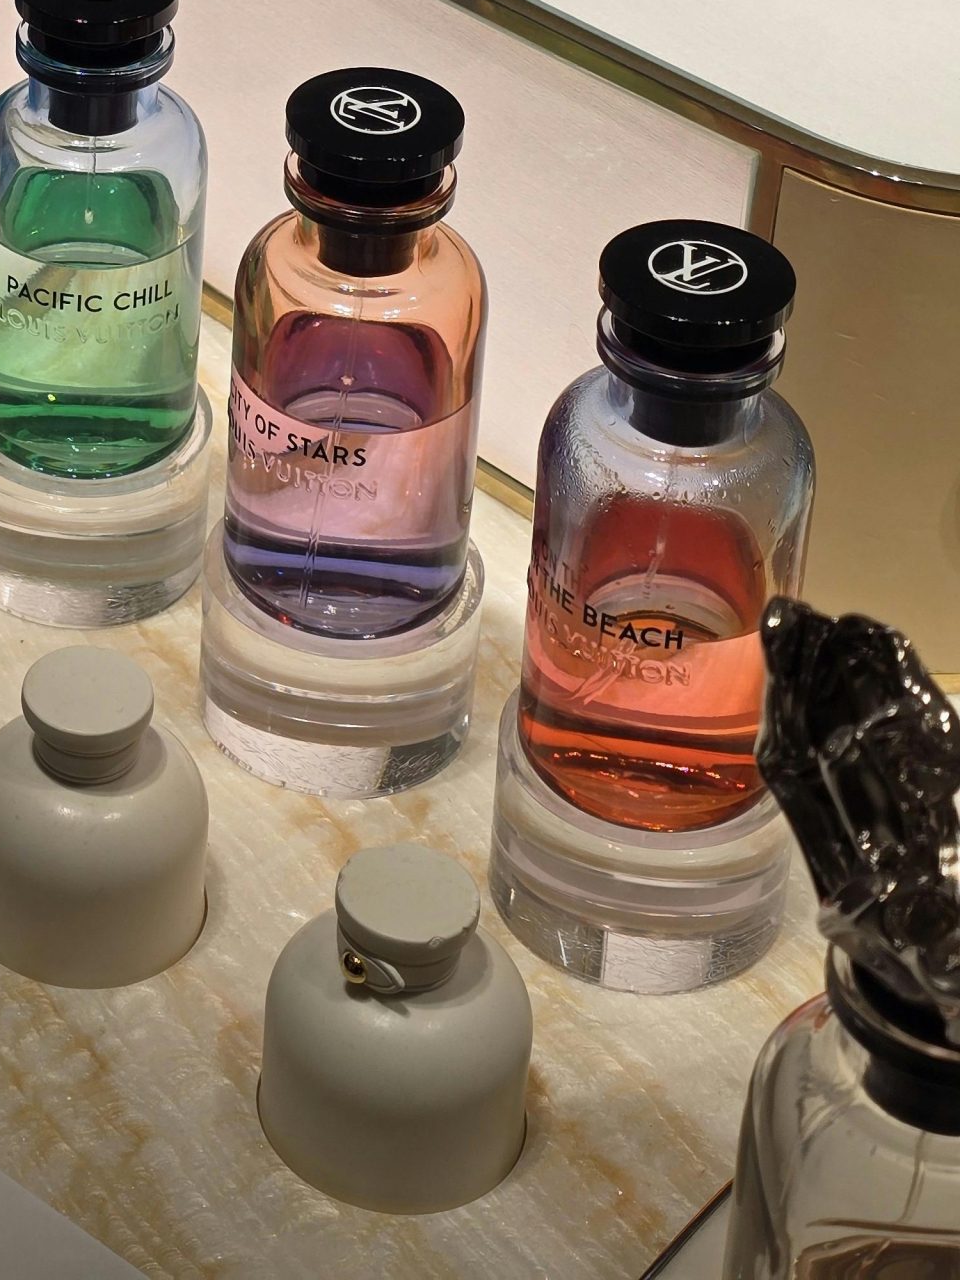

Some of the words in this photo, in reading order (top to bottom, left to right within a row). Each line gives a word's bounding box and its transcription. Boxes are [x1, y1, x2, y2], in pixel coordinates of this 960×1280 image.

[7, 275, 103, 313] PACIFIC
[113, 279, 173, 311] CHILL
[75, 302, 179, 344] VUITTON
[255, 414, 280, 440] OF
[287, 433, 367, 467] STARS
[261, 448, 378, 502] VUITTON
[543, 566, 575, 616] THE
[583, 604, 683, 650] BEACH
